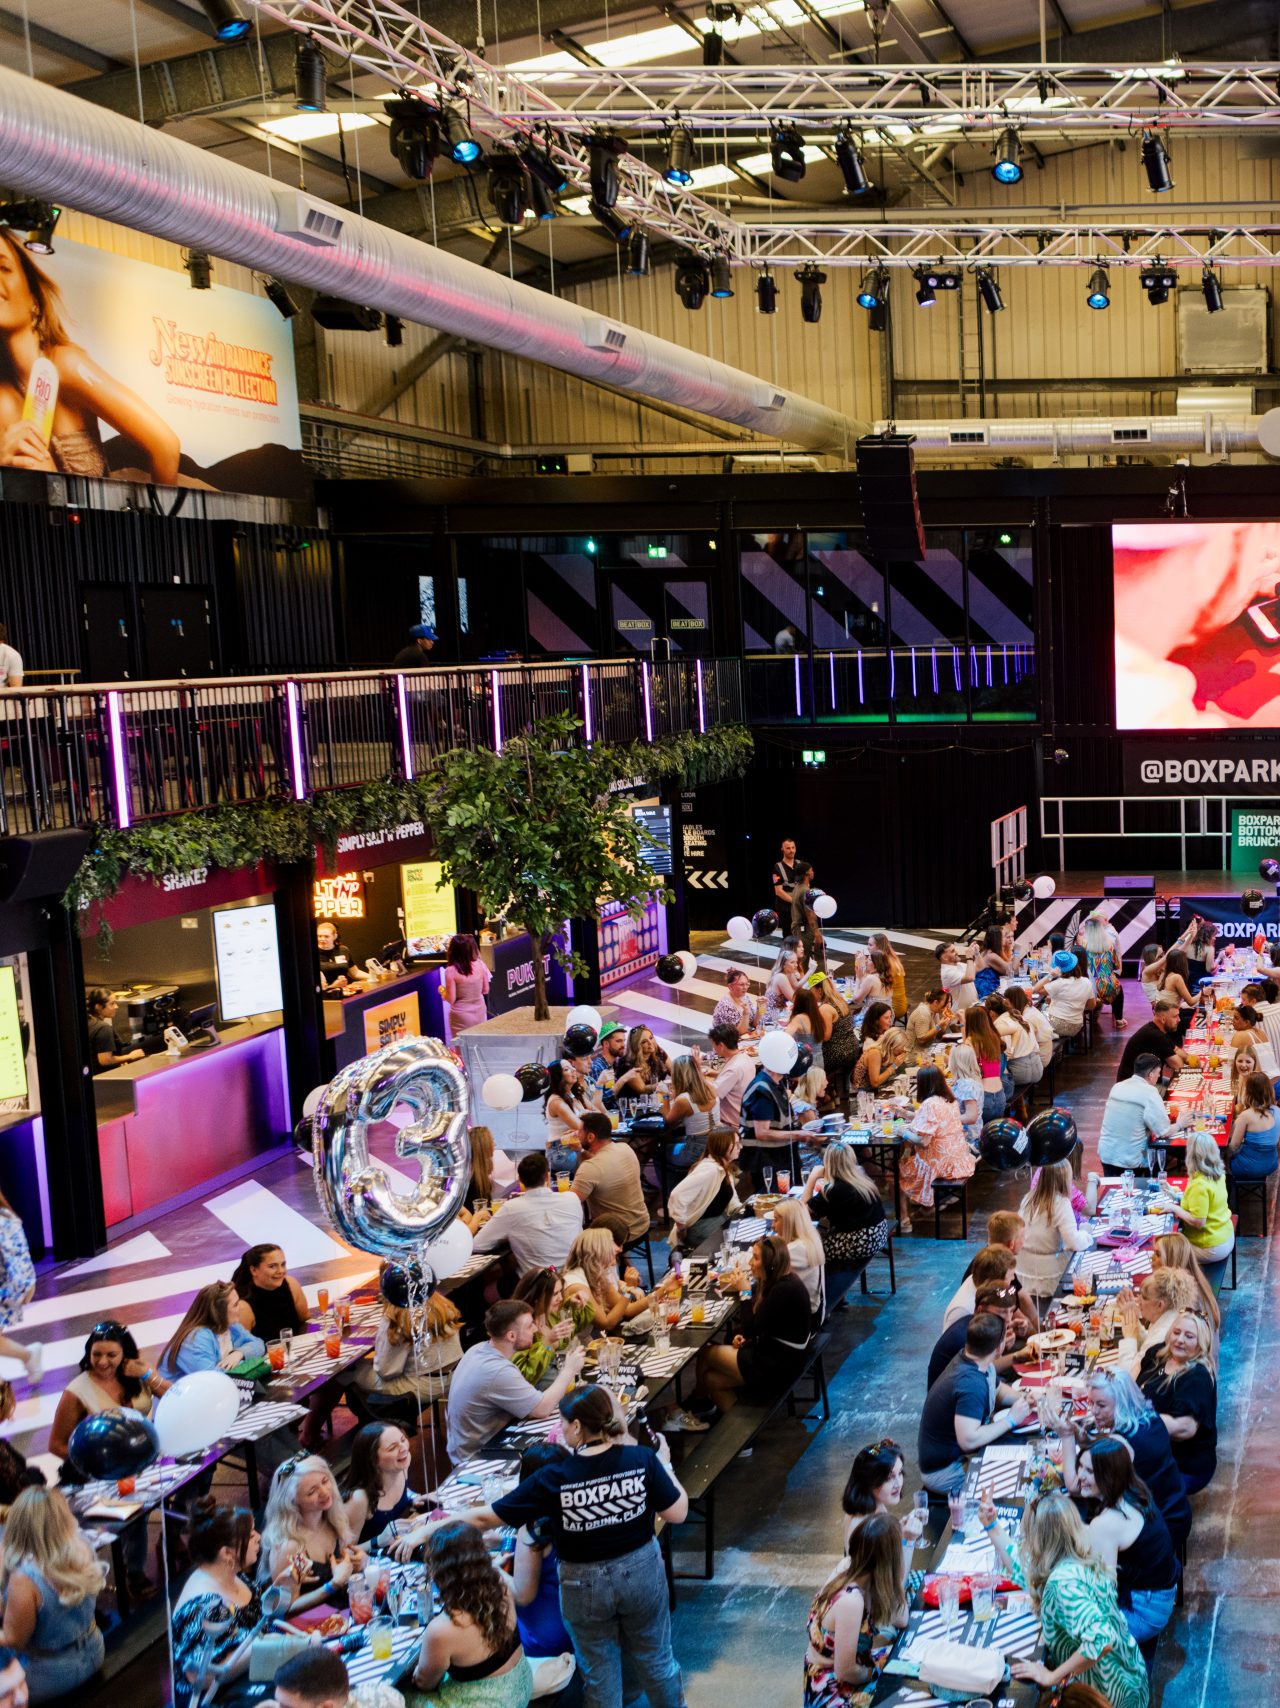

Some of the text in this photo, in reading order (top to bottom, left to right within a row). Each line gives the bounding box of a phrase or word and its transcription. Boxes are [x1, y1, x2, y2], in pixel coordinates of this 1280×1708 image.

[165, 357, 278, 406] SUNSCREEN COLLECTION
[337, 834, 366, 853] SIMPLY
[396, 820, 425, 841] PEPPER
[163, 868, 208, 891] SHAKE?
[314, 898, 363, 918] PPER
[507, 954, 551, 990] PUKT
[231, 1378, 254, 1389] SERVED
[561, 1475, 646, 1508] BOXPARK
